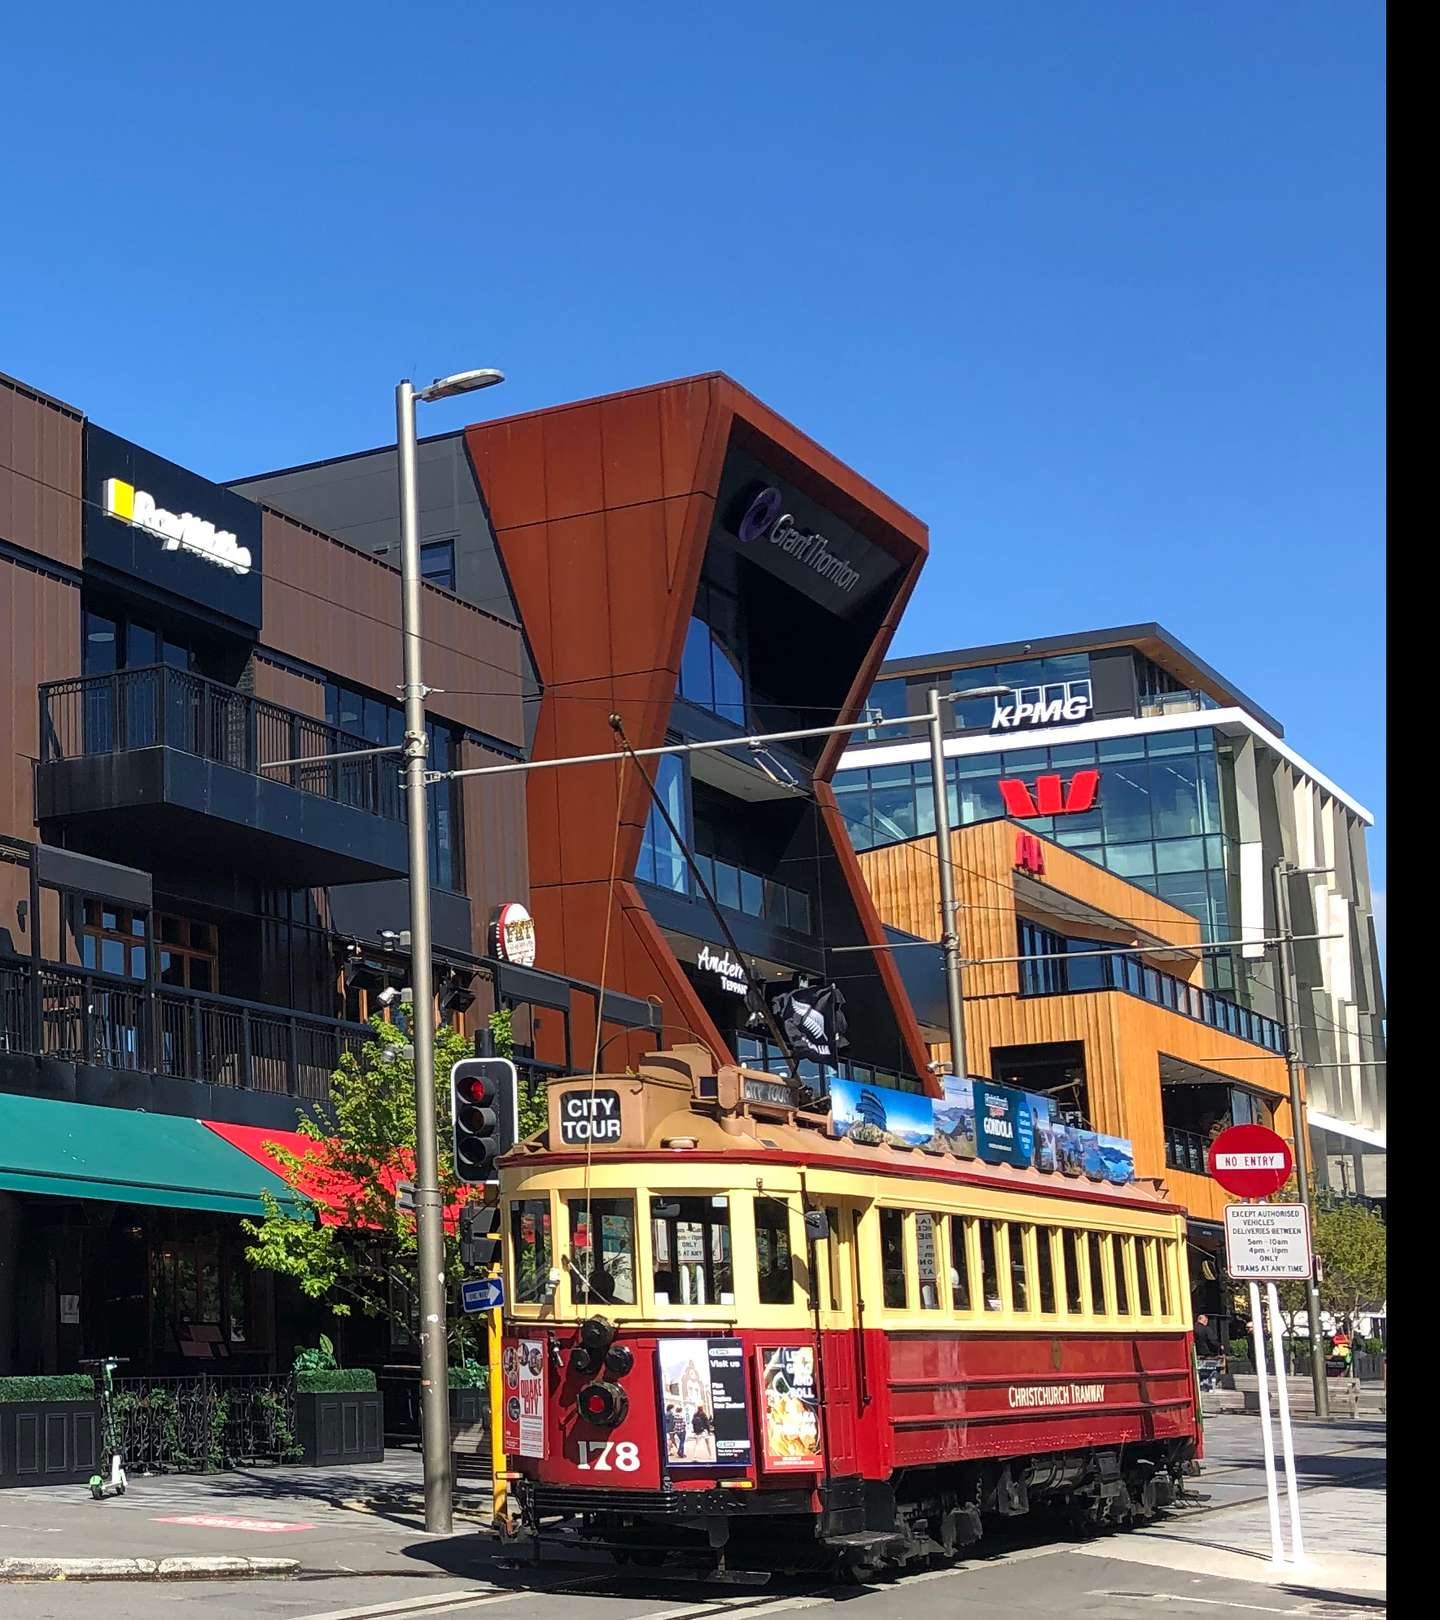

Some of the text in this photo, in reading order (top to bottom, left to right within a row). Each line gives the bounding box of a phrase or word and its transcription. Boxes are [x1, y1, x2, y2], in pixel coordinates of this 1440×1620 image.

[770, 513, 860, 592] Grant Thornton
[991, 696, 1088, 728] KPMG
[567, 1097, 615, 1118] CITY
[562, 1119, 621, 1139] TOUR
[983, 1117, 1014, 1139] GONDOLA
[1225, 1155, 1275, 1167] NO ENTRY
[1231, 1210, 1300, 1218] EXCEPT AUTHORISED
[1232, 1227, 1302, 1235] DELIVERIES BETWEEN
[1248, 1246, 1266, 1255] 4pm
[1236, 1264, 1260, 1272] TRAMS
[1008, 1383, 1105, 1408] CHRISTCHURCH TRAMWAY
[577, 1441, 641, 1472] 178
